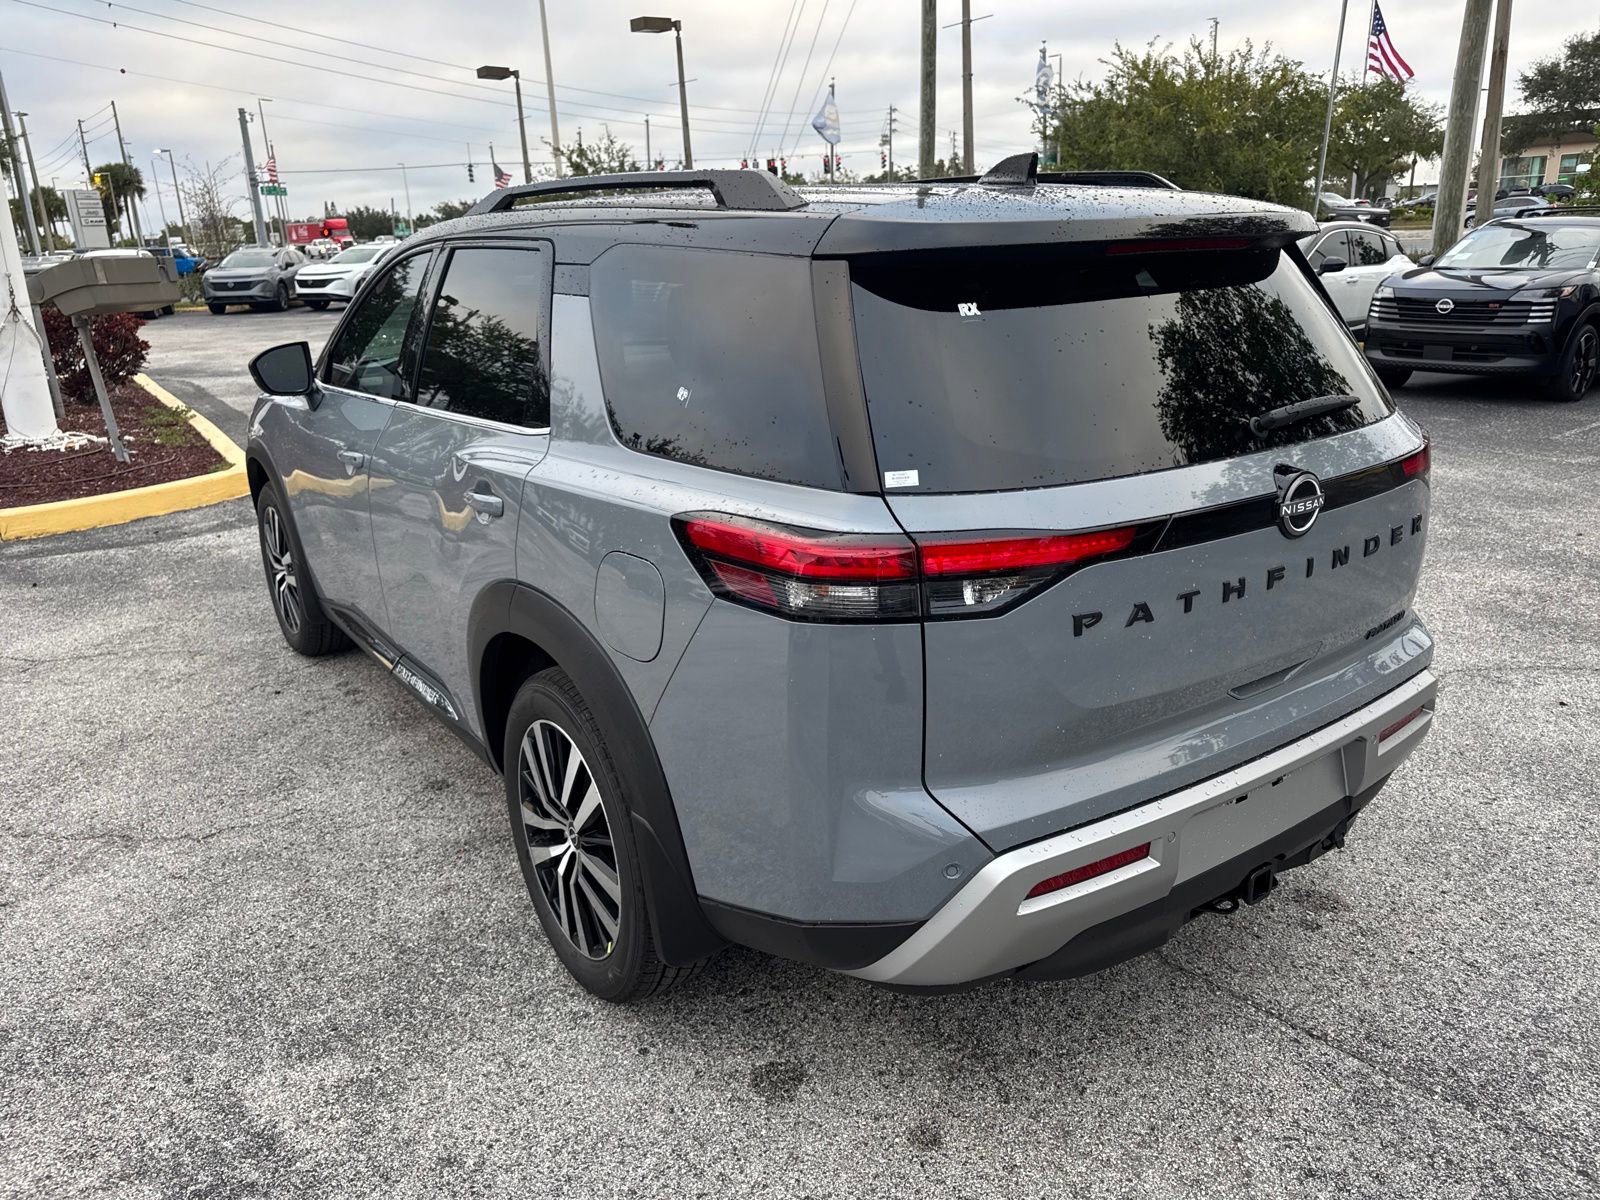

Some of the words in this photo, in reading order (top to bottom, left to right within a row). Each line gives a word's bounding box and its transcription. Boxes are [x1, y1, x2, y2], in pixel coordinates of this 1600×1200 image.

[957, 302, 982, 317] RX
[1281, 496, 1325, 516] NISSAN
[1071, 512, 1424, 638] PATHFINDER
